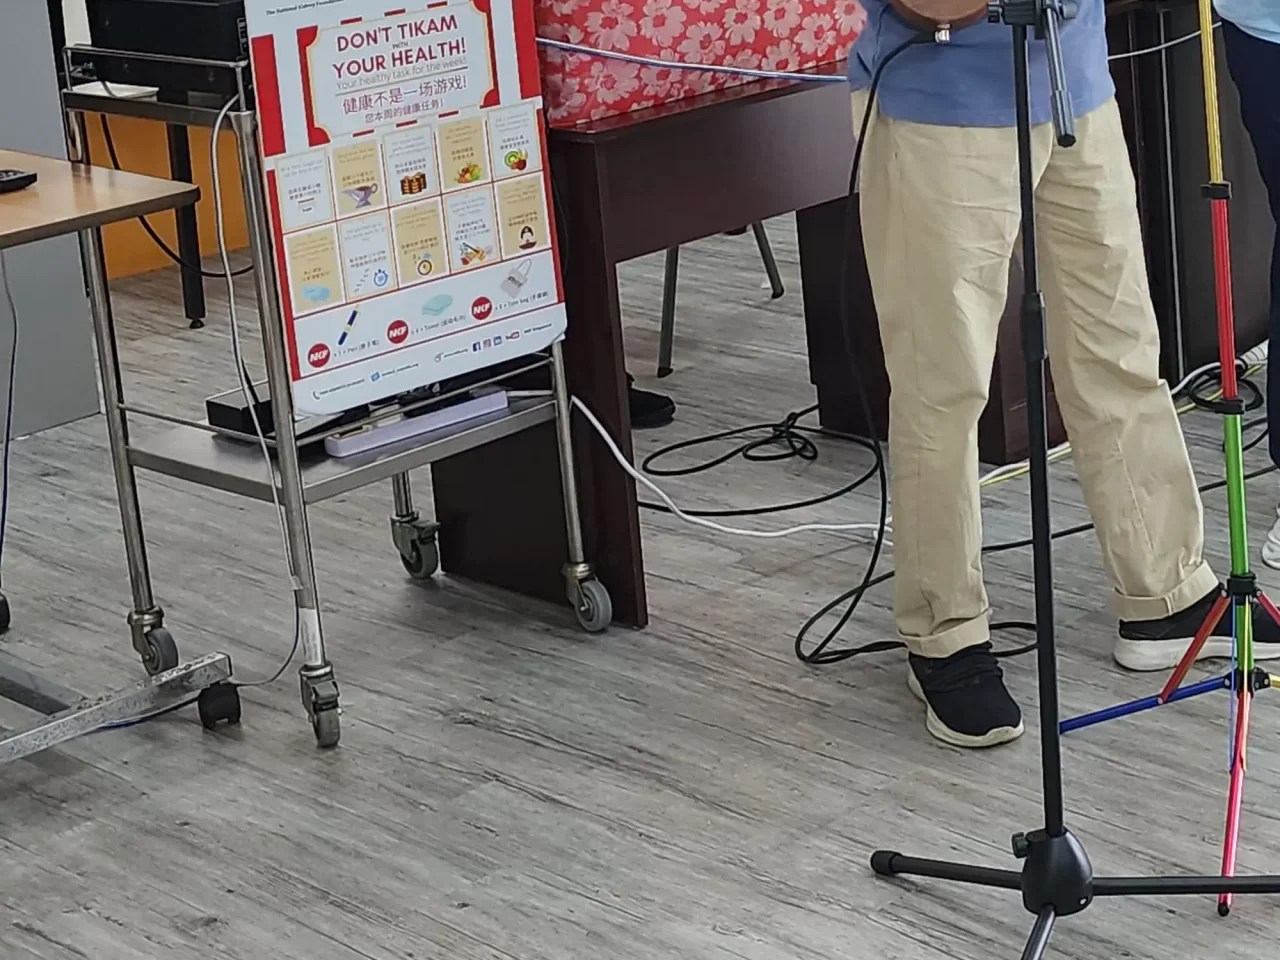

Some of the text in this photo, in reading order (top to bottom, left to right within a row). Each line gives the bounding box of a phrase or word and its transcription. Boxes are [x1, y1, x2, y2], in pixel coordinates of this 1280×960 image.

[337, 14, 458, 52] DON'T TIKAM
[392, 41, 409, 49] WITH
[332, 37, 466, 79] YOUR HEALTH!
[336, 78, 359, 90] Your
[359, 70, 391, 86] healthy
[392, 67, 412, 79] task
[412, 65, 425, 76] for
[426, 62, 443, 72] the
[473, 303, 490, 315] NKF
[389, 326, 407, 338] NKF
[310, 349, 328, 362] NKF
